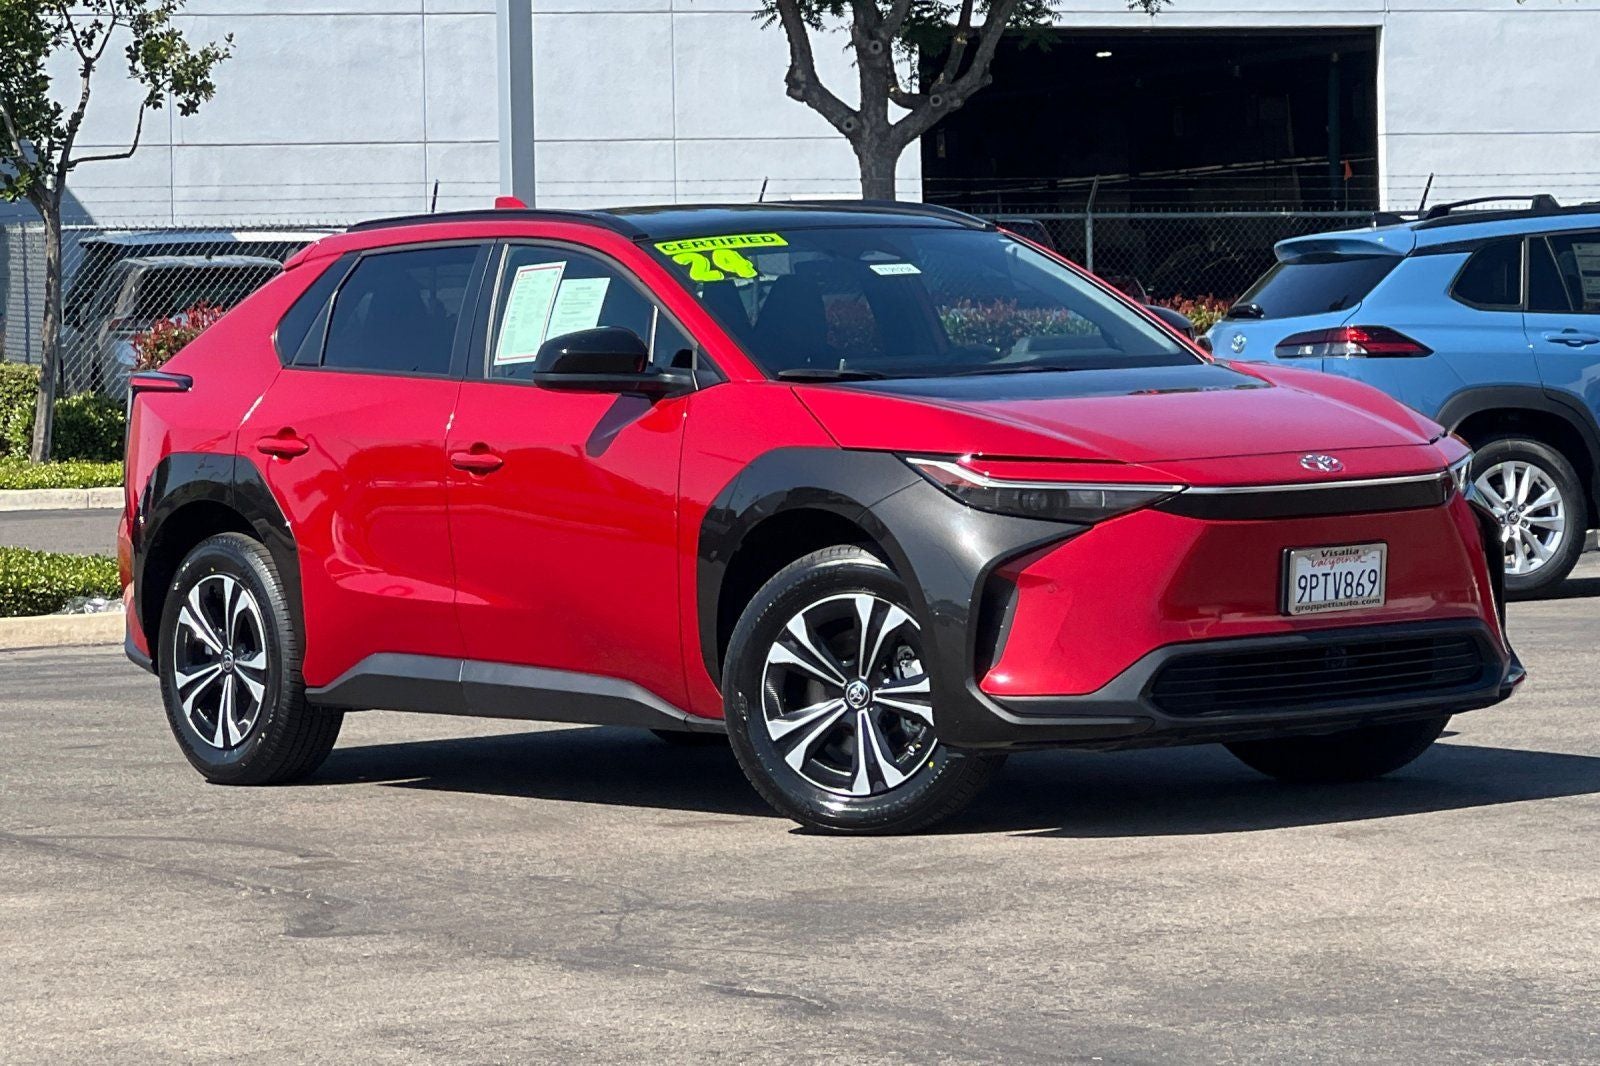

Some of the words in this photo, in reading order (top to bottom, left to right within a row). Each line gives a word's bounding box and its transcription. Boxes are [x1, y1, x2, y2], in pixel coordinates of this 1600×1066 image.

[662, 235, 776, 251] CERTIFIED
[672, 249, 758, 281] 24
[1321, 548, 1359, 557] Visalia
[1298, 569, 1377, 603] 9PTV869
[1295, 598, 1381, 613] groppettiauto.com
